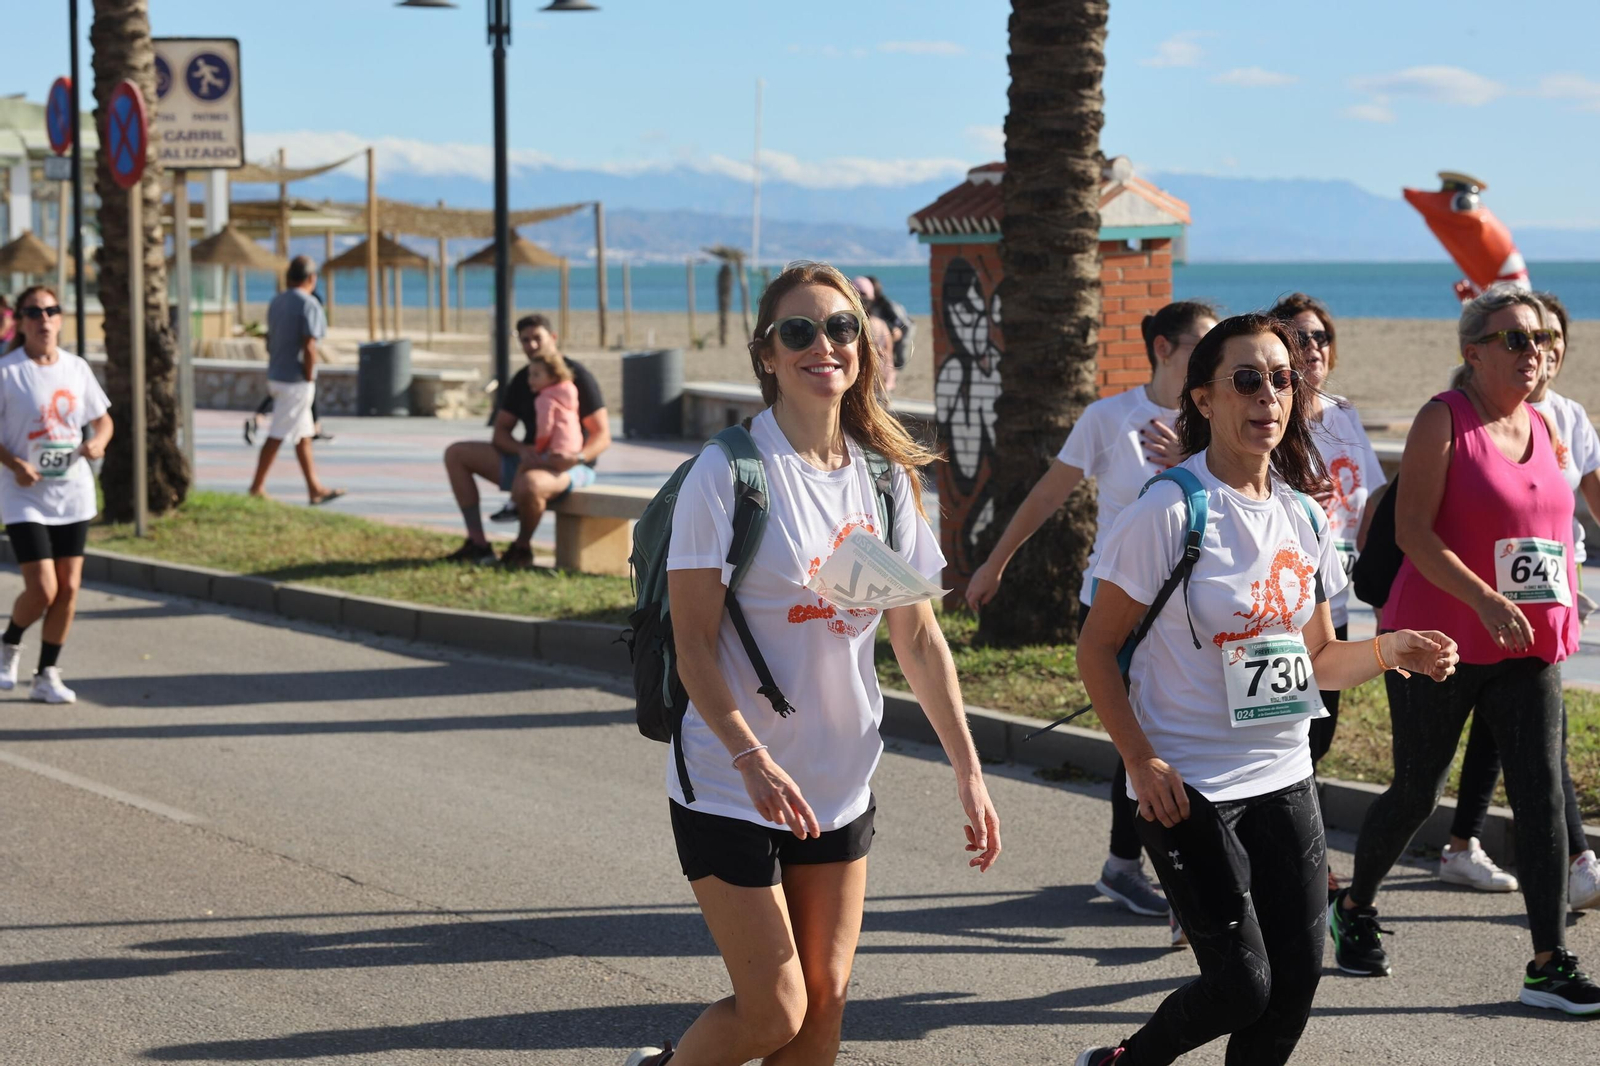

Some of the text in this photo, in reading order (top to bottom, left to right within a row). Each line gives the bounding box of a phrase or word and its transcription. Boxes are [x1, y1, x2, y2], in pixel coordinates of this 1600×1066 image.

[164, 129, 225, 142] CARRIL
[40, 450, 72, 468] 651
[1511, 555, 1560, 583] 642
[1244, 656, 1309, 698] 730
[1236, 709, 1255, 720] 024
